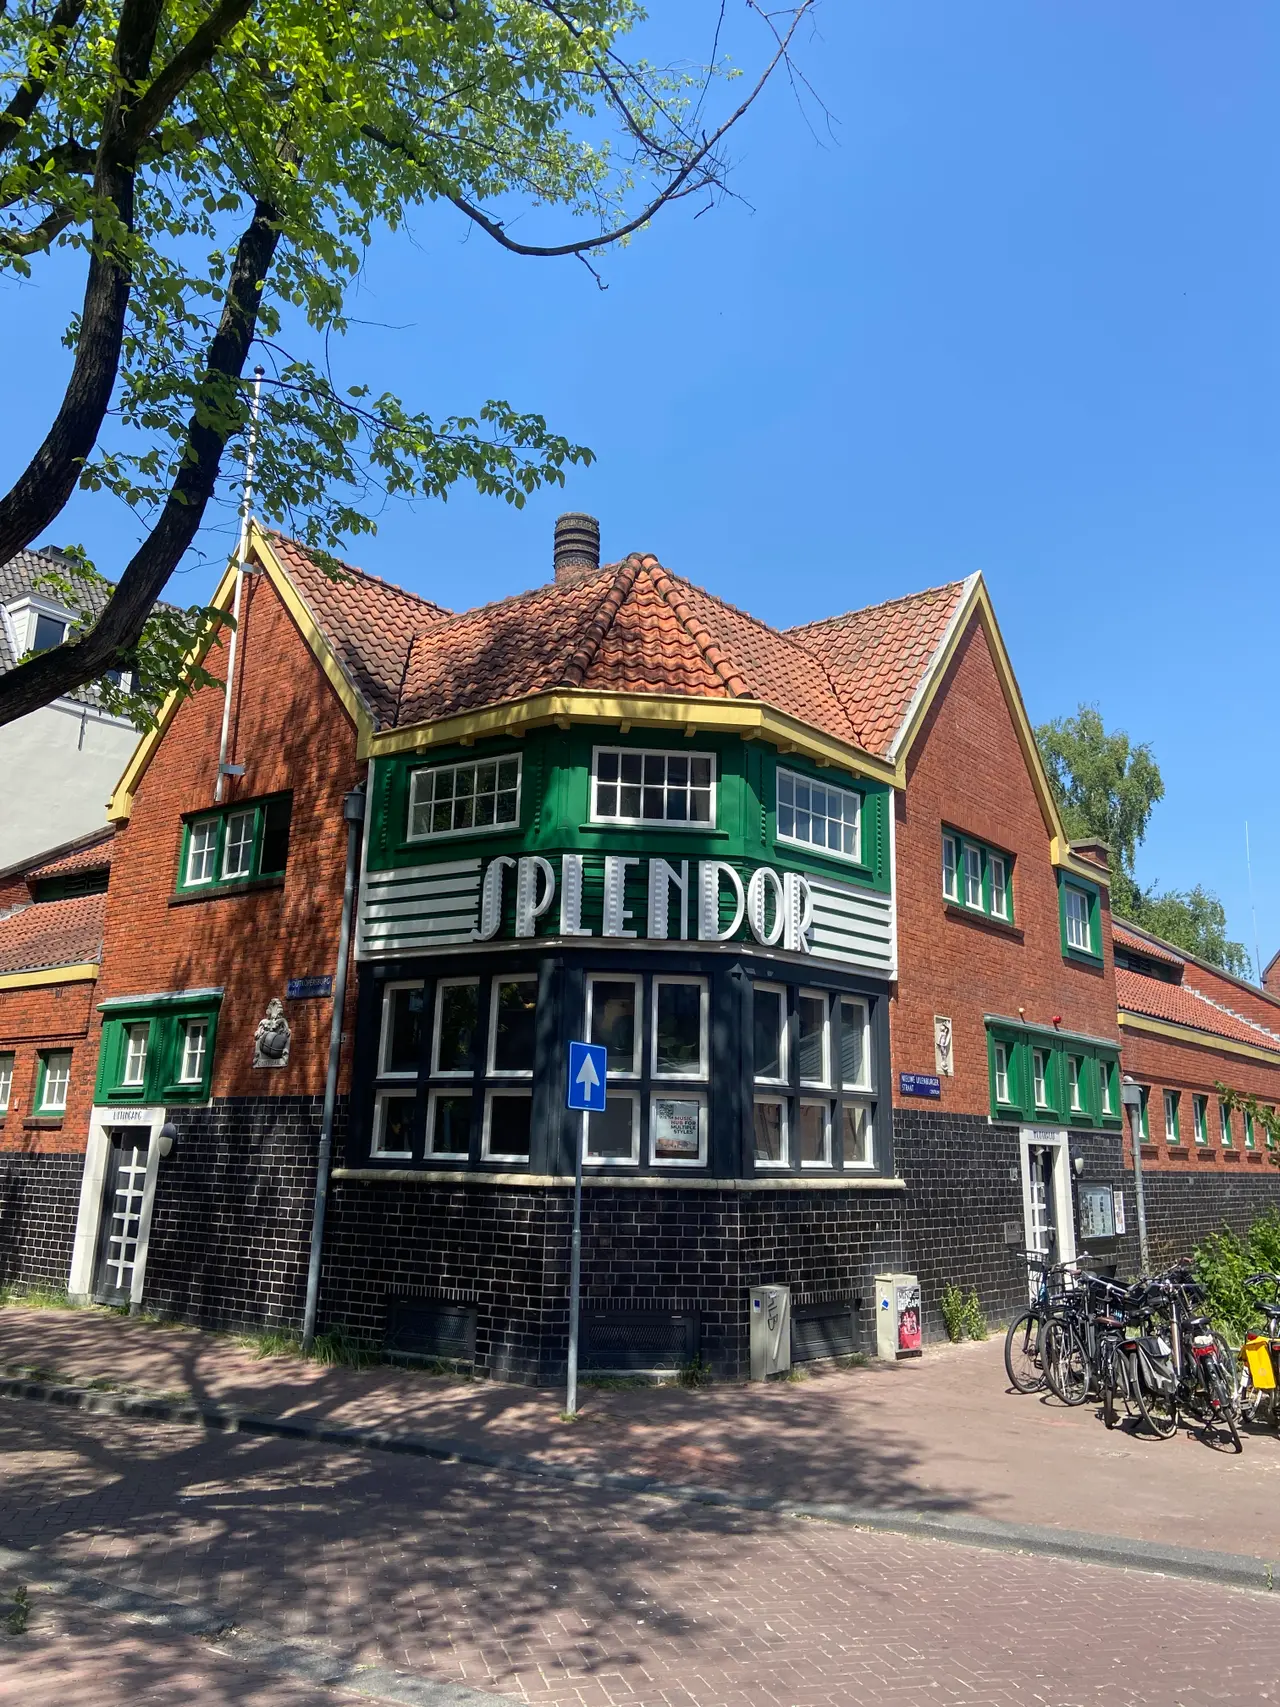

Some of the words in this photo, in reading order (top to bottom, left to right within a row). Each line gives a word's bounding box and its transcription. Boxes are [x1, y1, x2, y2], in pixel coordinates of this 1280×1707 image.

[471, 853, 813, 954] SPLENDOR
[901, 1074, 915, 1084] NIEUWE
[915, 1076, 939, 1087] UILENBURGER
[901, 1083, 914, 1092] STRAAT
